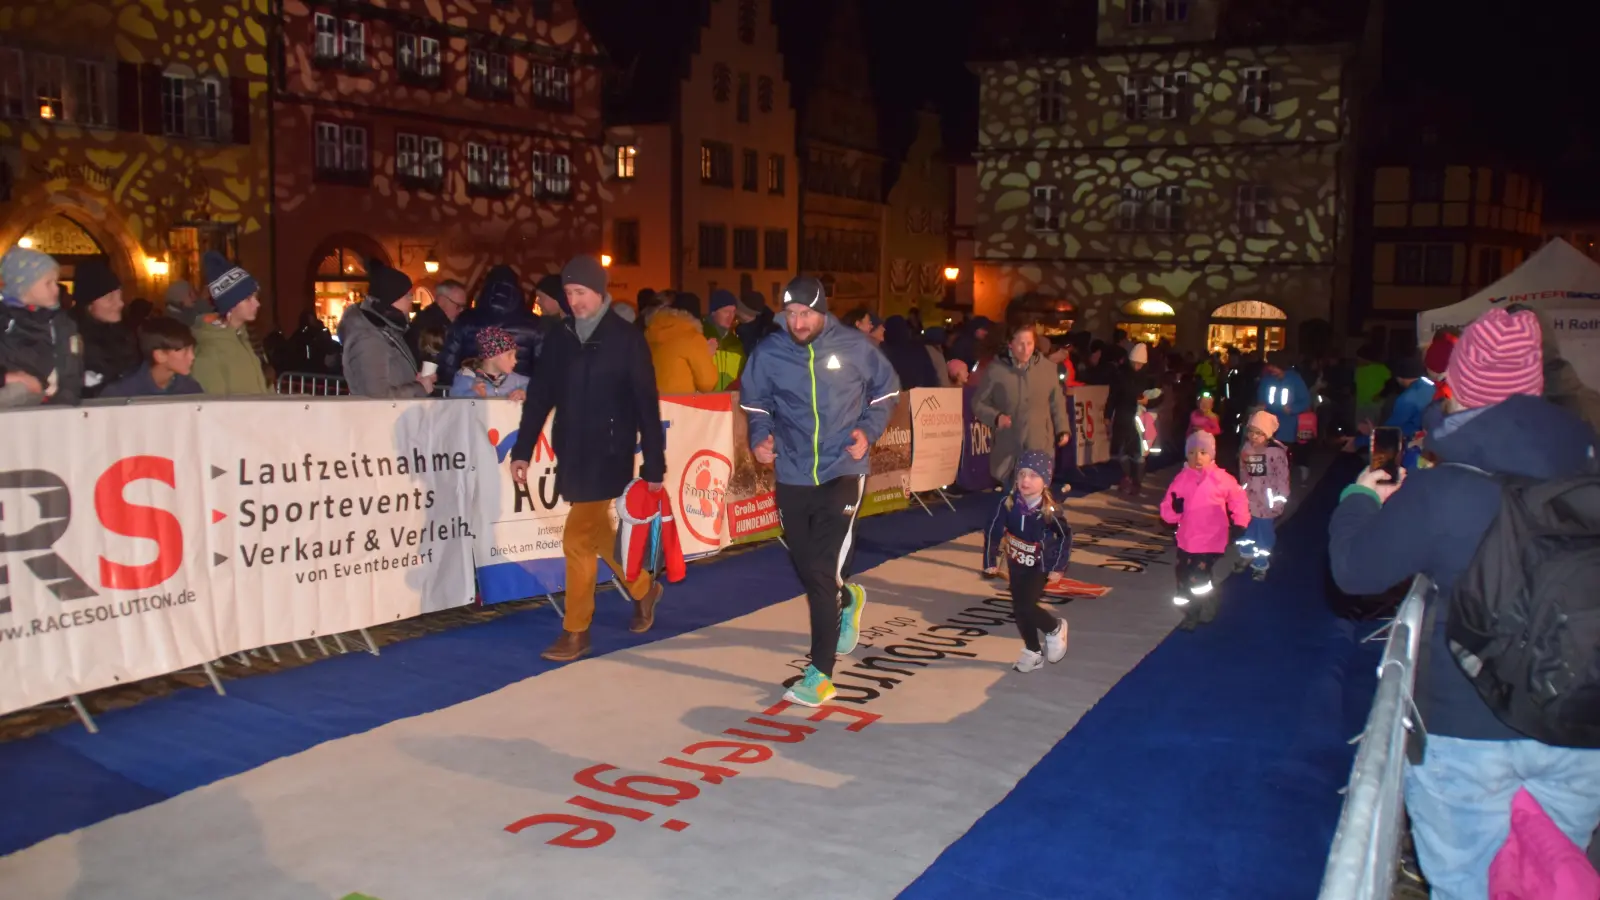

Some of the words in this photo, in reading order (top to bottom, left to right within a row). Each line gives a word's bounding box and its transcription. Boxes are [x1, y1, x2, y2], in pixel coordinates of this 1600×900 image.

[239, 447, 466, 486] Laufzeitnahme
[239, 488, 435, 532] Sportevents
[240, 530, 356, 568] Verkauf
[364, 529, 381, 552] &
[296, 568, 327, 584] von
[334, 548, 433, 578] Eventbedarf
[491, 544, 518, 557] Direkt
[519, 543, 534, 553] am
[535, 539, 563, 551] Röder
[884, 616, 917, 628] ob
[502, 700, 884, 849] Energie
